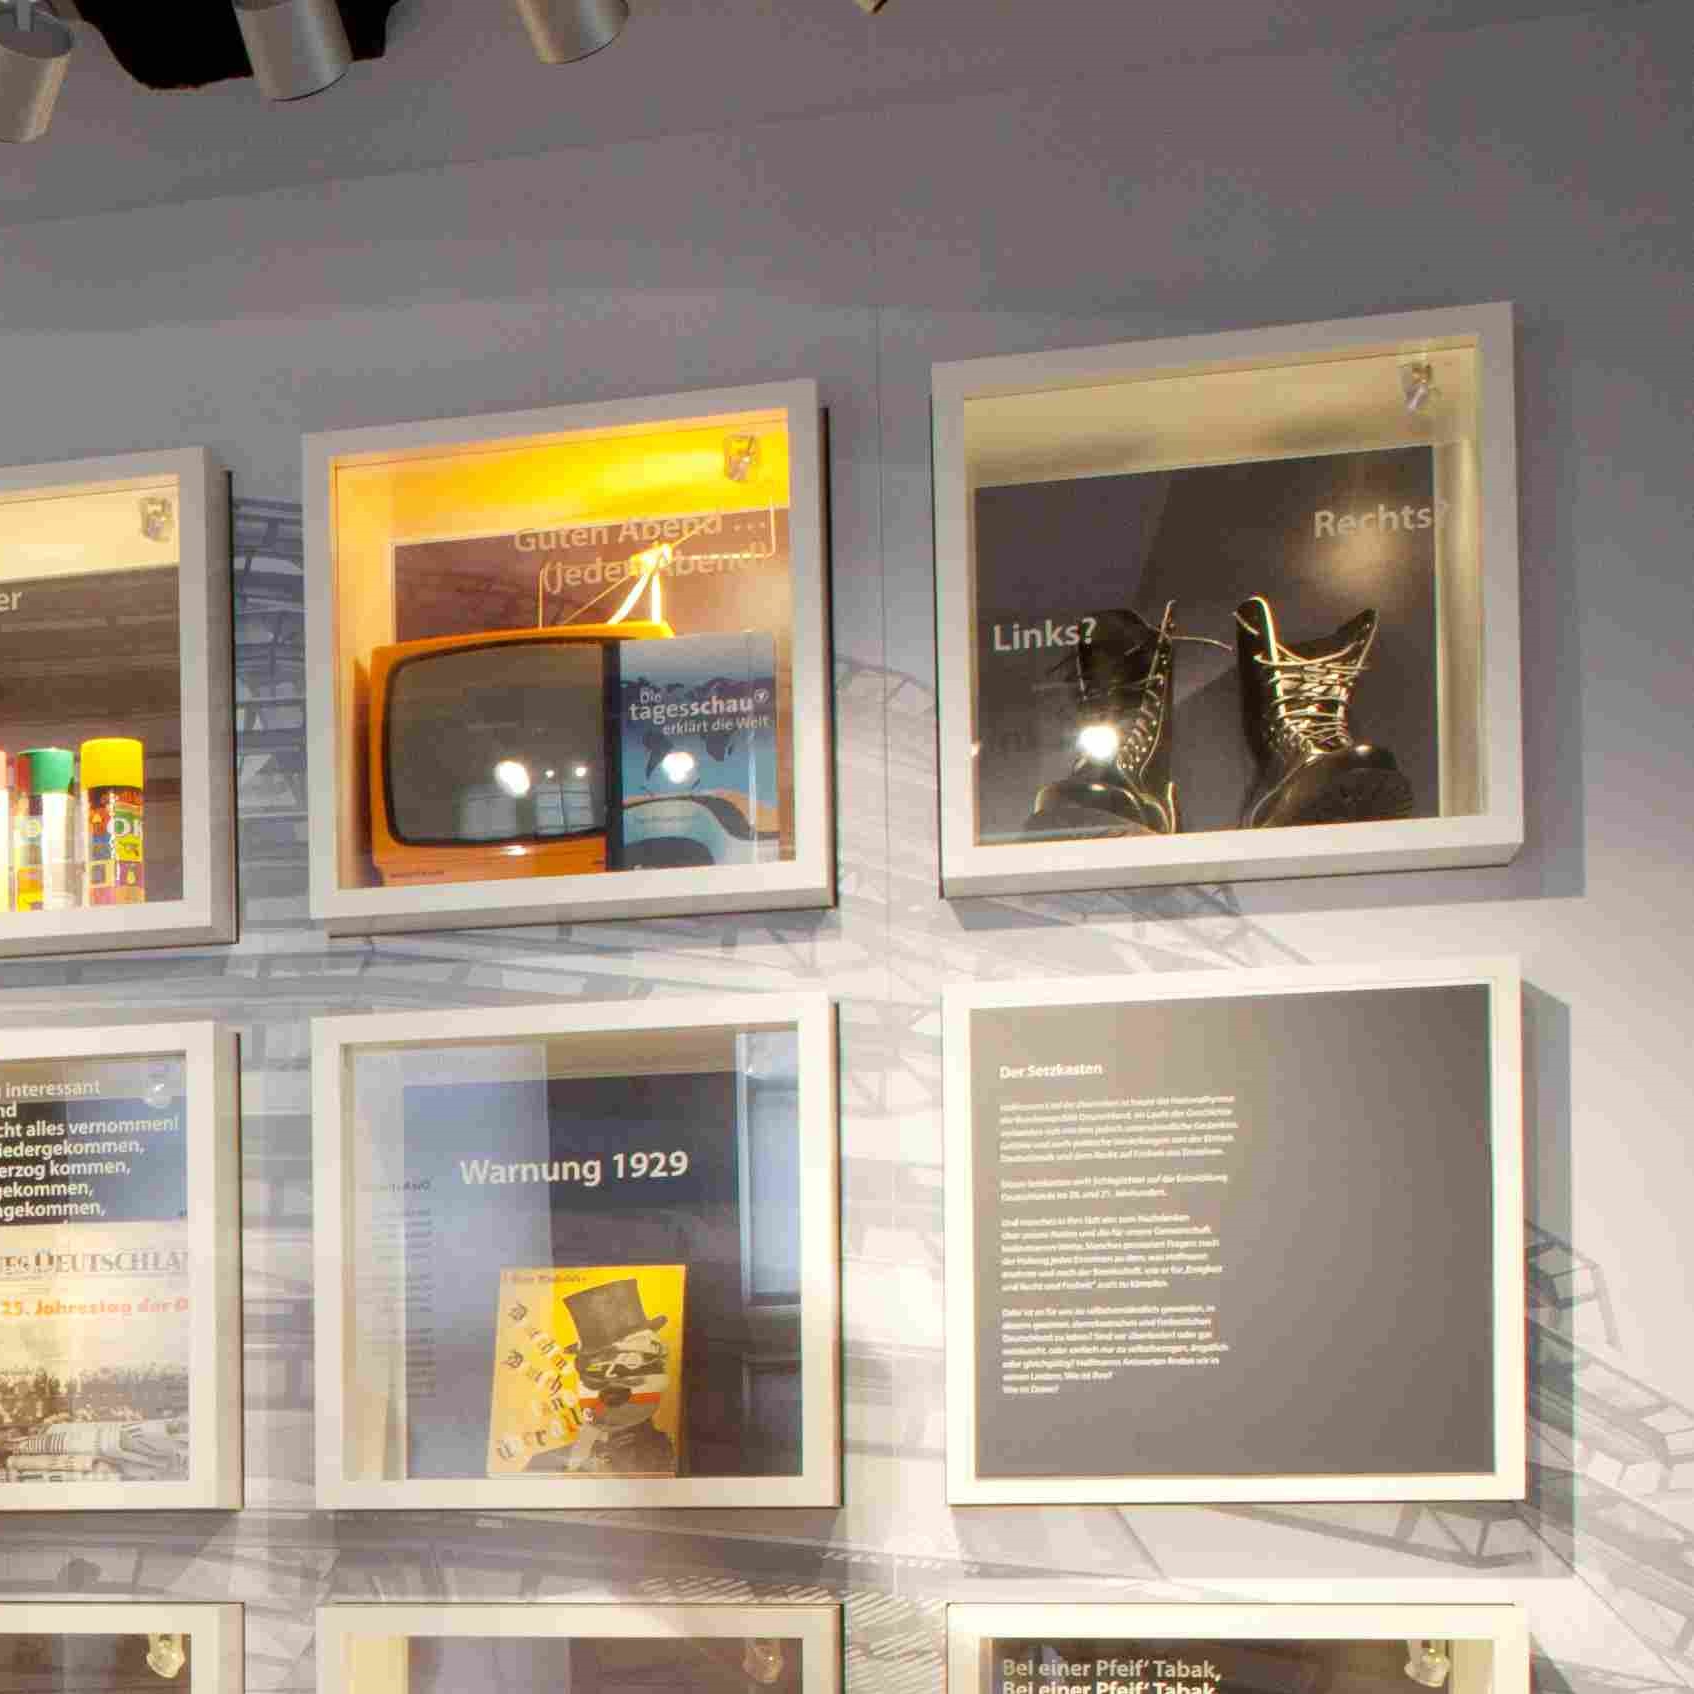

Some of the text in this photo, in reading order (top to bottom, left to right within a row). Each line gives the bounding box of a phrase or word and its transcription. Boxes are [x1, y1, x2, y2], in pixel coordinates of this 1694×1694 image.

[514, 513, 724, 552] Guten Abend
[994, 616, 1098, 651] Links?
[639, 687, 662, 704] Die
[629, 696, 755, 725] tagesschau
[662, 716, 769, 736] erklärt die Welt
[999, 1062, 1104, 1080] Der Setzkasten
[5, 1079, 102, 1099] interessant
[26, 1120, 65, 1137] alles
[49, 1159, 132, 1177] kommen,
[460, 1158, 602, 1187] Warnung
[612, 1149, 689, 1179] 1929
[1003, 1659, 1034, 1677] Bei
[1039, 1660, 1091, 1677] einer
[1153, 1659, 1221, 1681] Tabak,
